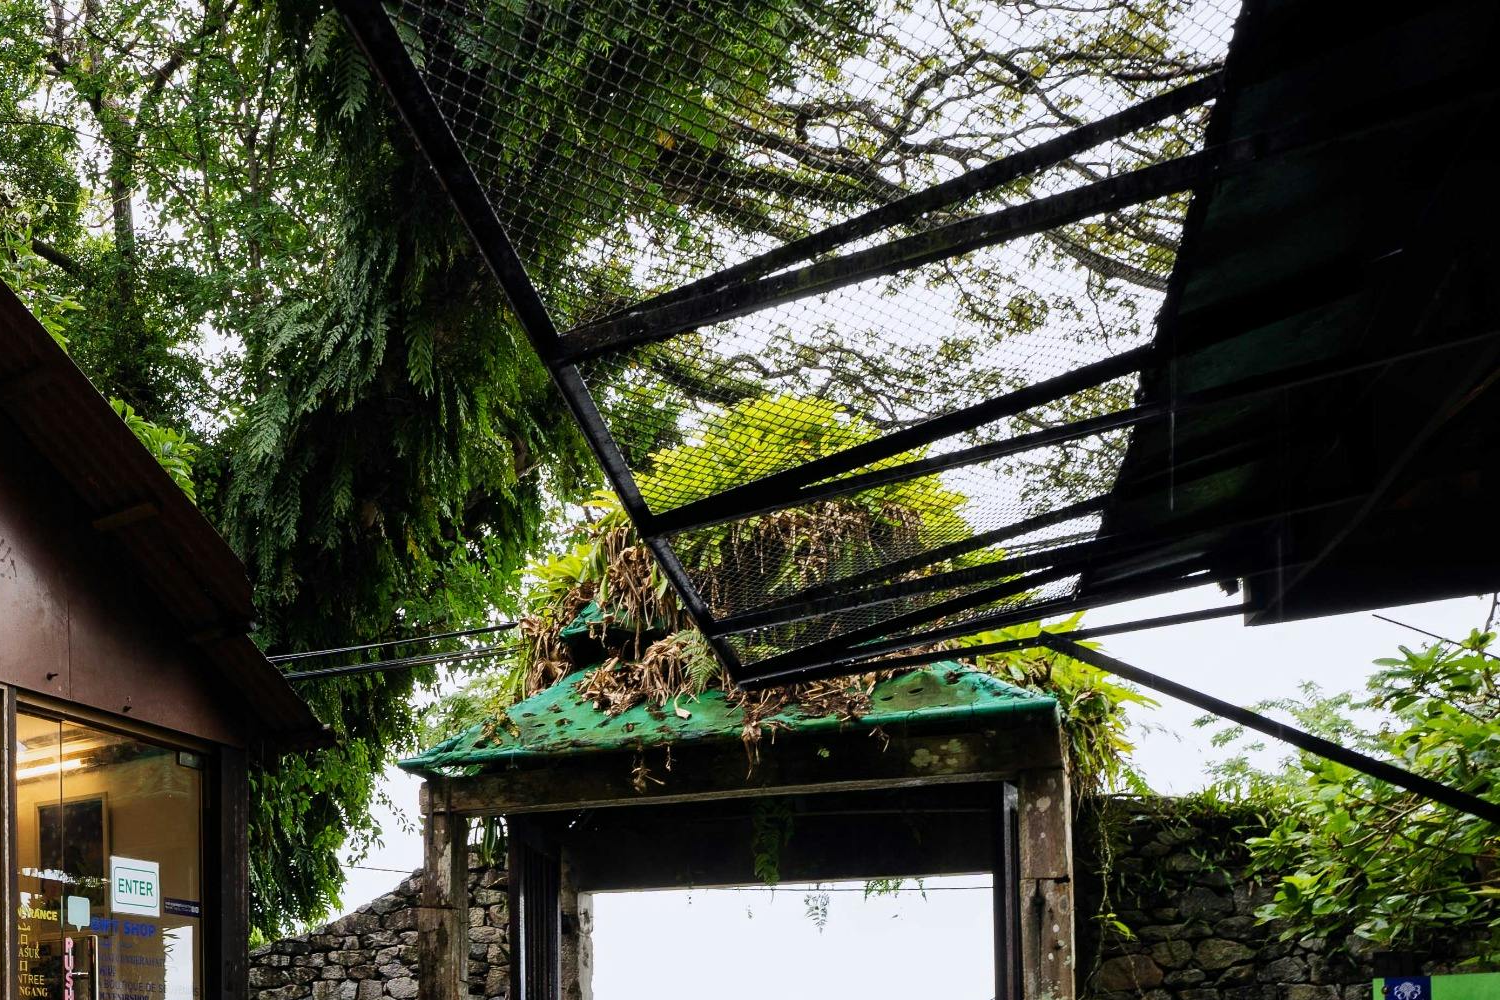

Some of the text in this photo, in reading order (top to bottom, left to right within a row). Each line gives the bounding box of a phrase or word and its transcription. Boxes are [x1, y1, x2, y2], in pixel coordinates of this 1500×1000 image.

[118, 878, 154, 897] ENTER
[123, 920, 156, 937] SHOP
[18, 947, 41, 959] ASUK
[18, 973, 45, 986] NTREE
